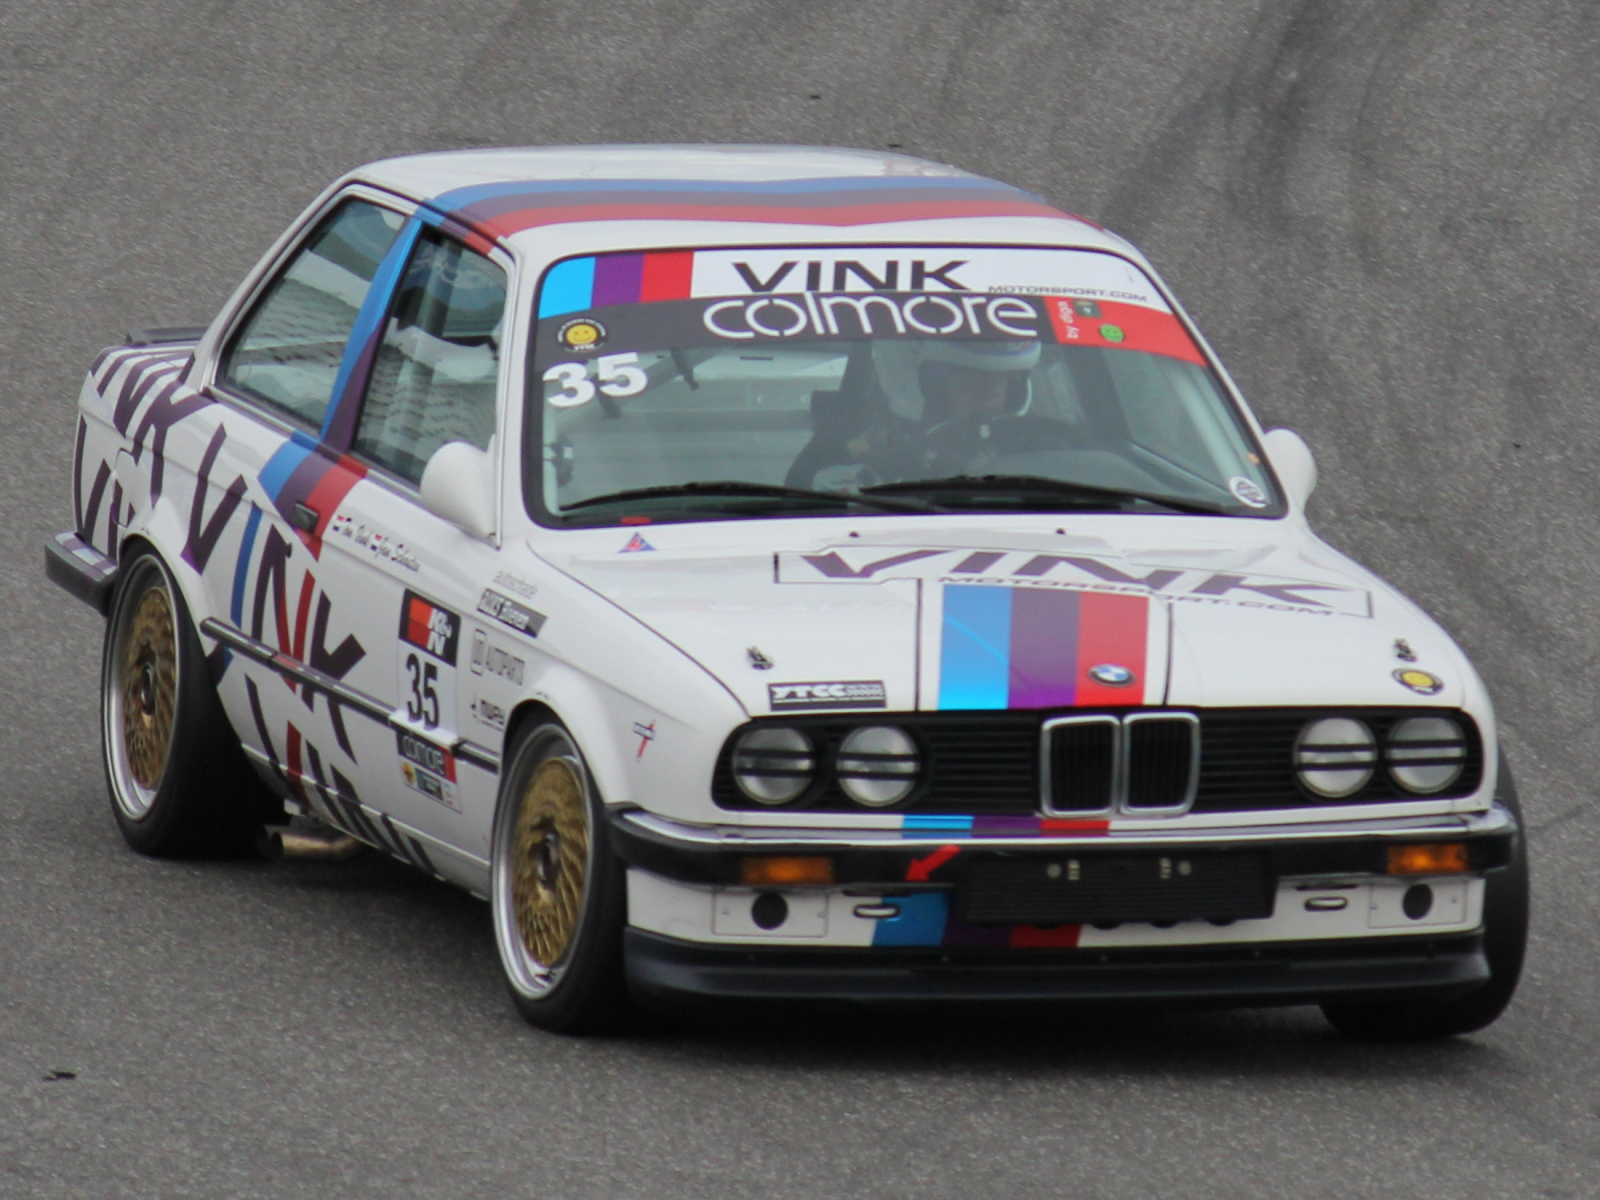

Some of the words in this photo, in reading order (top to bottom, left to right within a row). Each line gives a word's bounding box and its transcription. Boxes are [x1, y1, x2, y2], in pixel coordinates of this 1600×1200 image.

[732, 260, 968, 293] VINK
[988, 285, 1148, 302] MOTORSPORT.COM
[703, 291, 1038, 339] colmore
[542, 351, 648, 407] 35
[801, 549, 1350, 609] VINK
[406, 652, 440, 731] 35
[770, 684, 847, 700] YTCC
